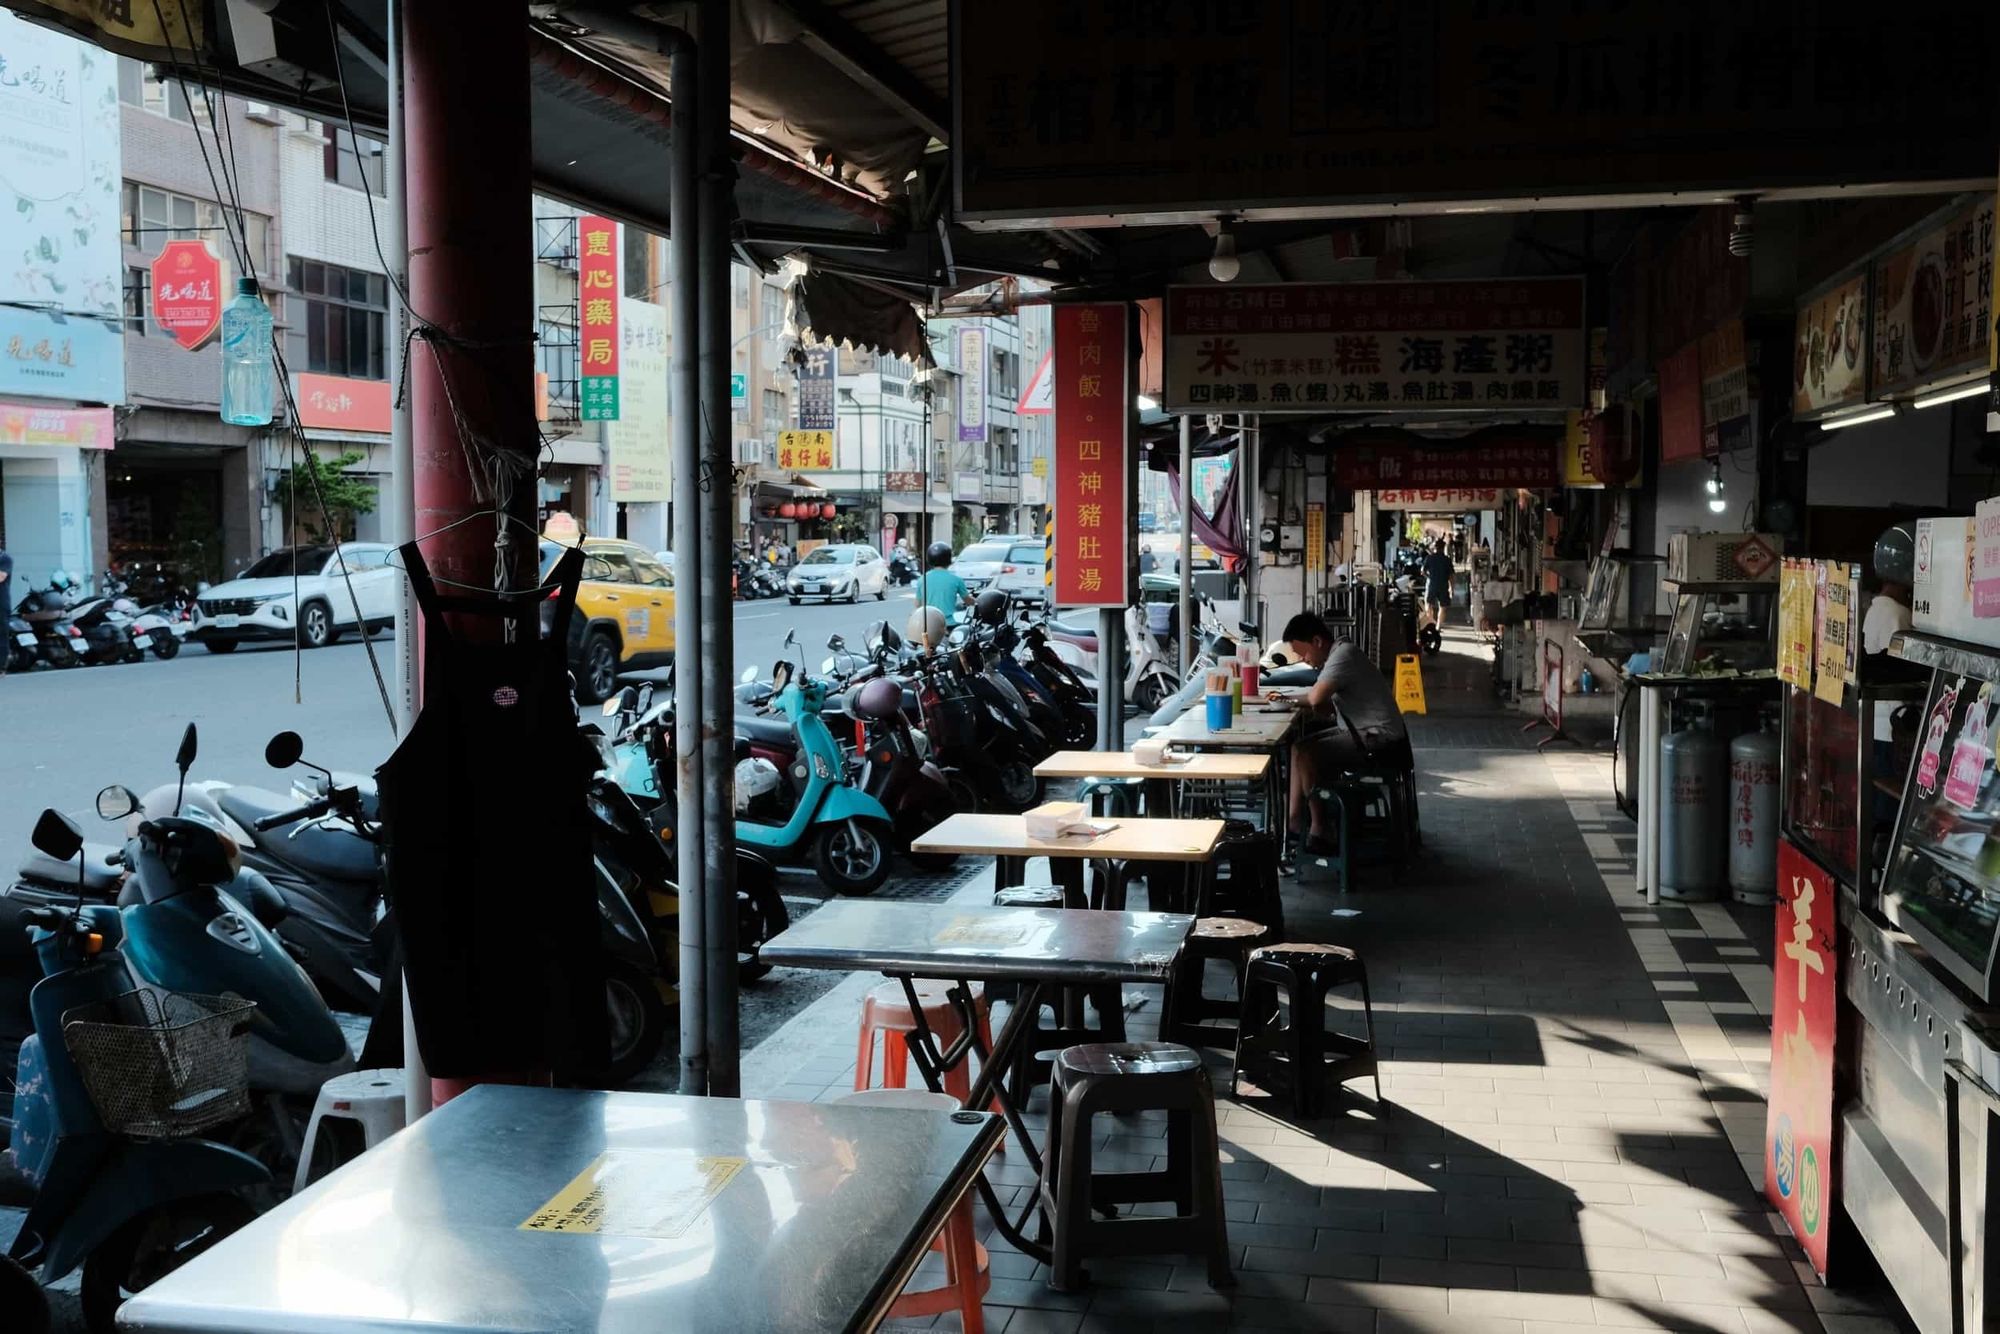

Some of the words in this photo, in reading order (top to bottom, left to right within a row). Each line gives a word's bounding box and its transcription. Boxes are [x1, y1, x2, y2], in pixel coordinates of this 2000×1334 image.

[584, 229, 614, 365] 惠心藥局
[1975, 208, 1993, 345] 花枝煎
[1196, 336, 1239, 377] 米
[1333, 335, 1381, 376] 糕
[1398, 334, 1553, 374] 海產粥
